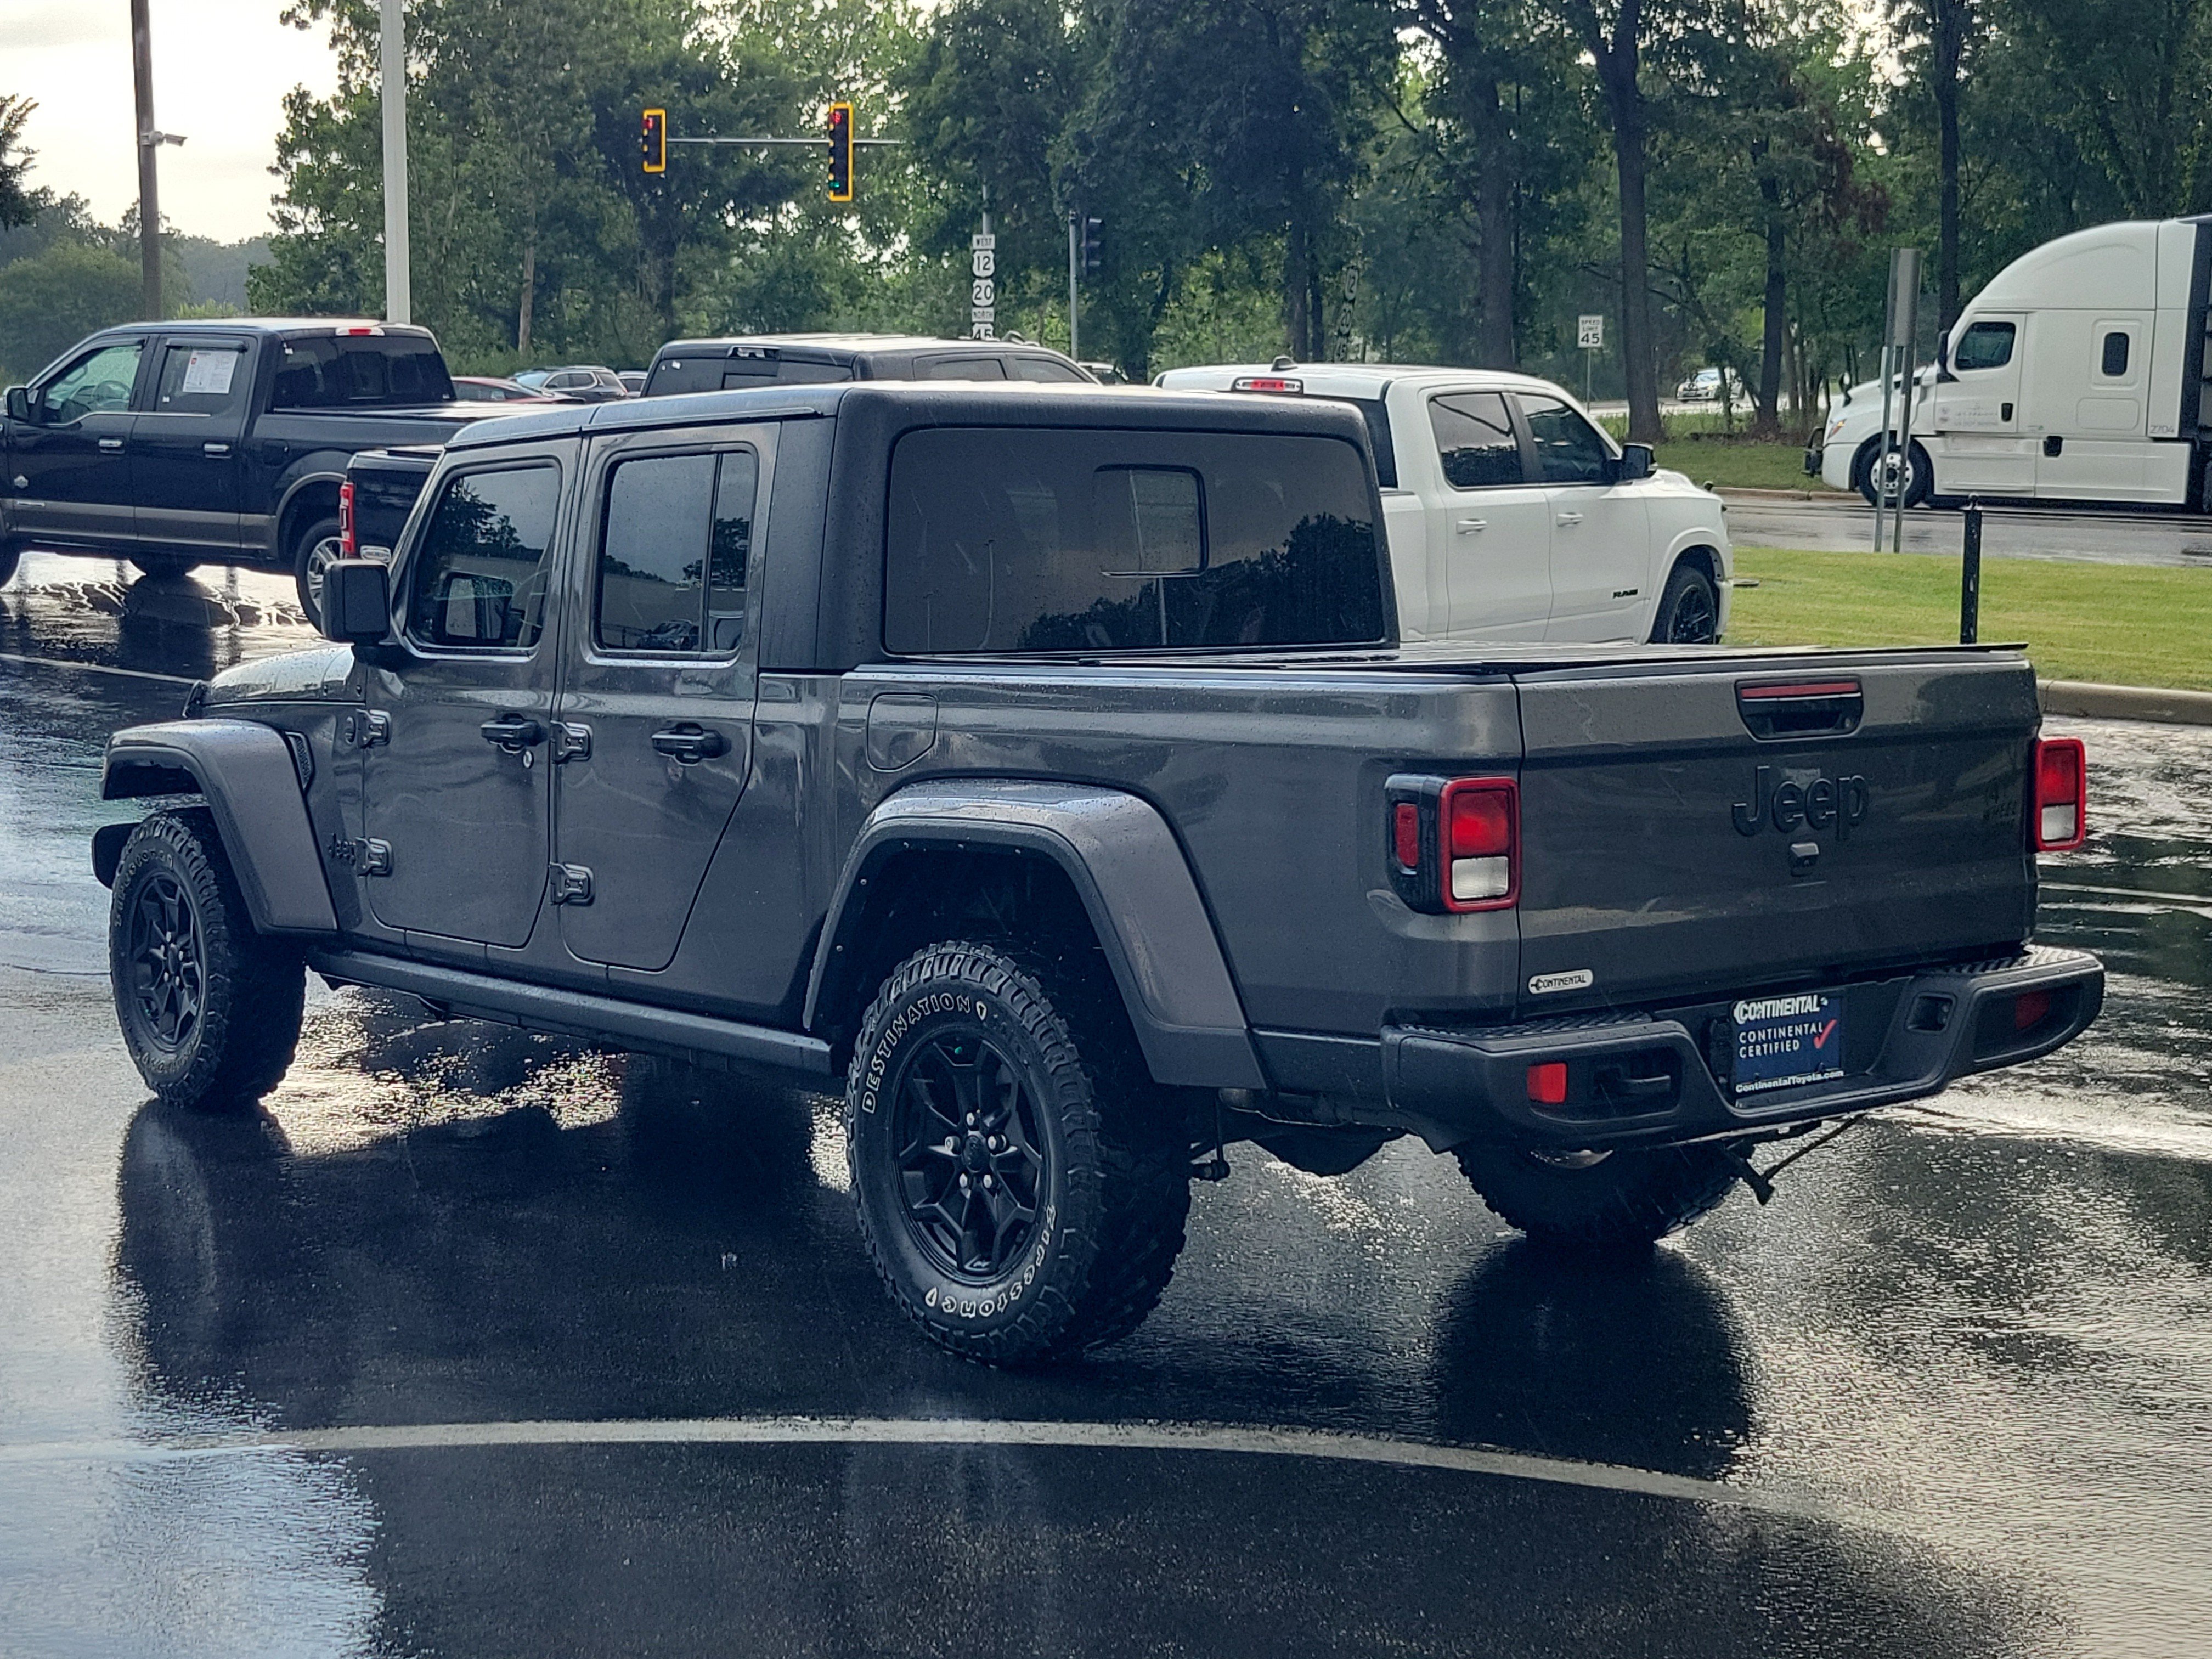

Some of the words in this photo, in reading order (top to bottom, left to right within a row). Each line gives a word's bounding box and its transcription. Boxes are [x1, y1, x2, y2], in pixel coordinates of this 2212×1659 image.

[975, 238, 992, 246] WEST
[977, 256, 991, 272] 12
[974, 285, 992, 300] 20
[1580, 332, 1600, 345] 45
[1731, 765, 1865, 841] Jeep
[1536, 974, 1587, 991] CONTINENTAL
[1734, 994, 1820, 1025] CONTINENTAL
[1739, 1022, 1824, 1044] CONTINENTAL
[861, 992, 971, 1114] DESTINATION
[1739, 1039, 1800, 1059] CERTIFIED
[1735, 1070, 1844, 1093] ContinentalToyota.com
